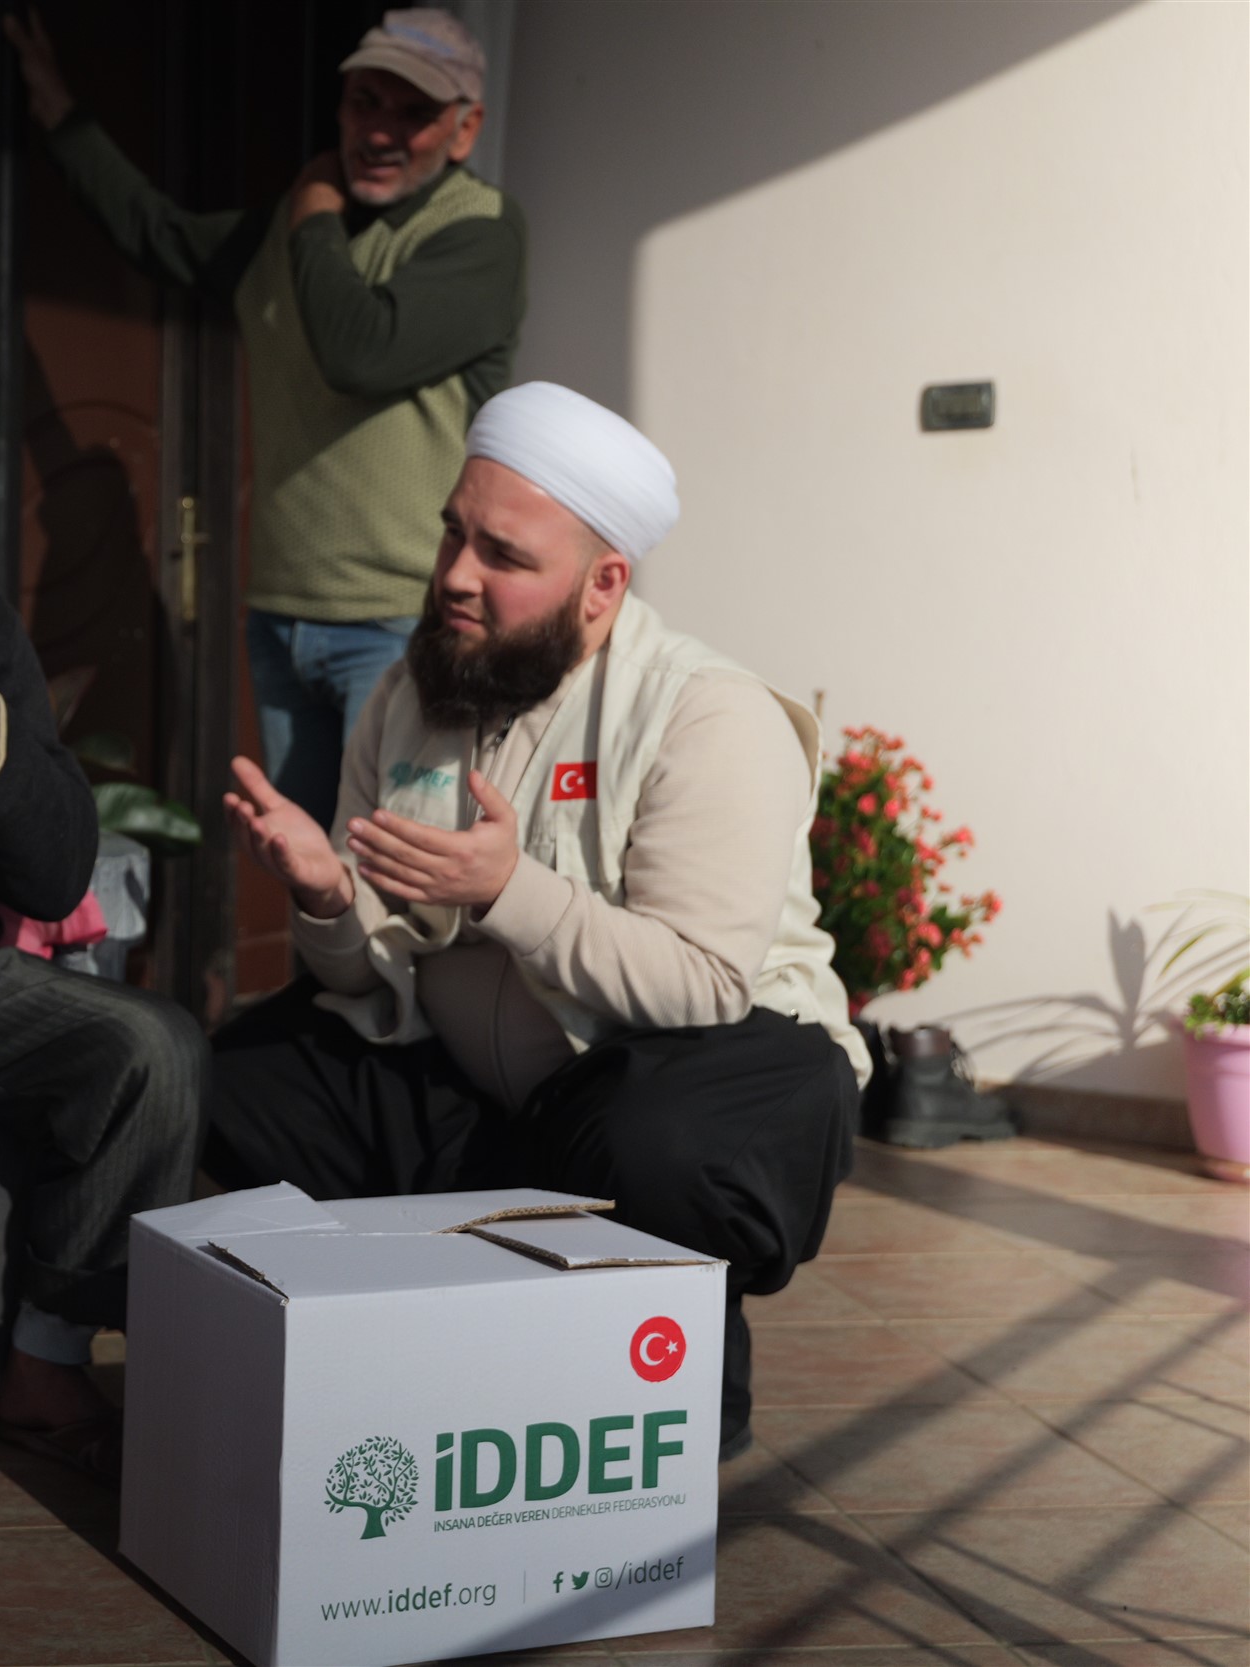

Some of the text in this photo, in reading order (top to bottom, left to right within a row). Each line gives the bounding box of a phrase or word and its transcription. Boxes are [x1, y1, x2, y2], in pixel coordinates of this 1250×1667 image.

[477, 1511, 513, 1528] DEĞER
[514, 1508, 550, 1523] VEREN
[551, 1501, 612, 1518] DERNEKLER
[612, 1493, 686, 1511] FEDERASYONU
[321, 1582, 497, 1621] www.iddef.org
